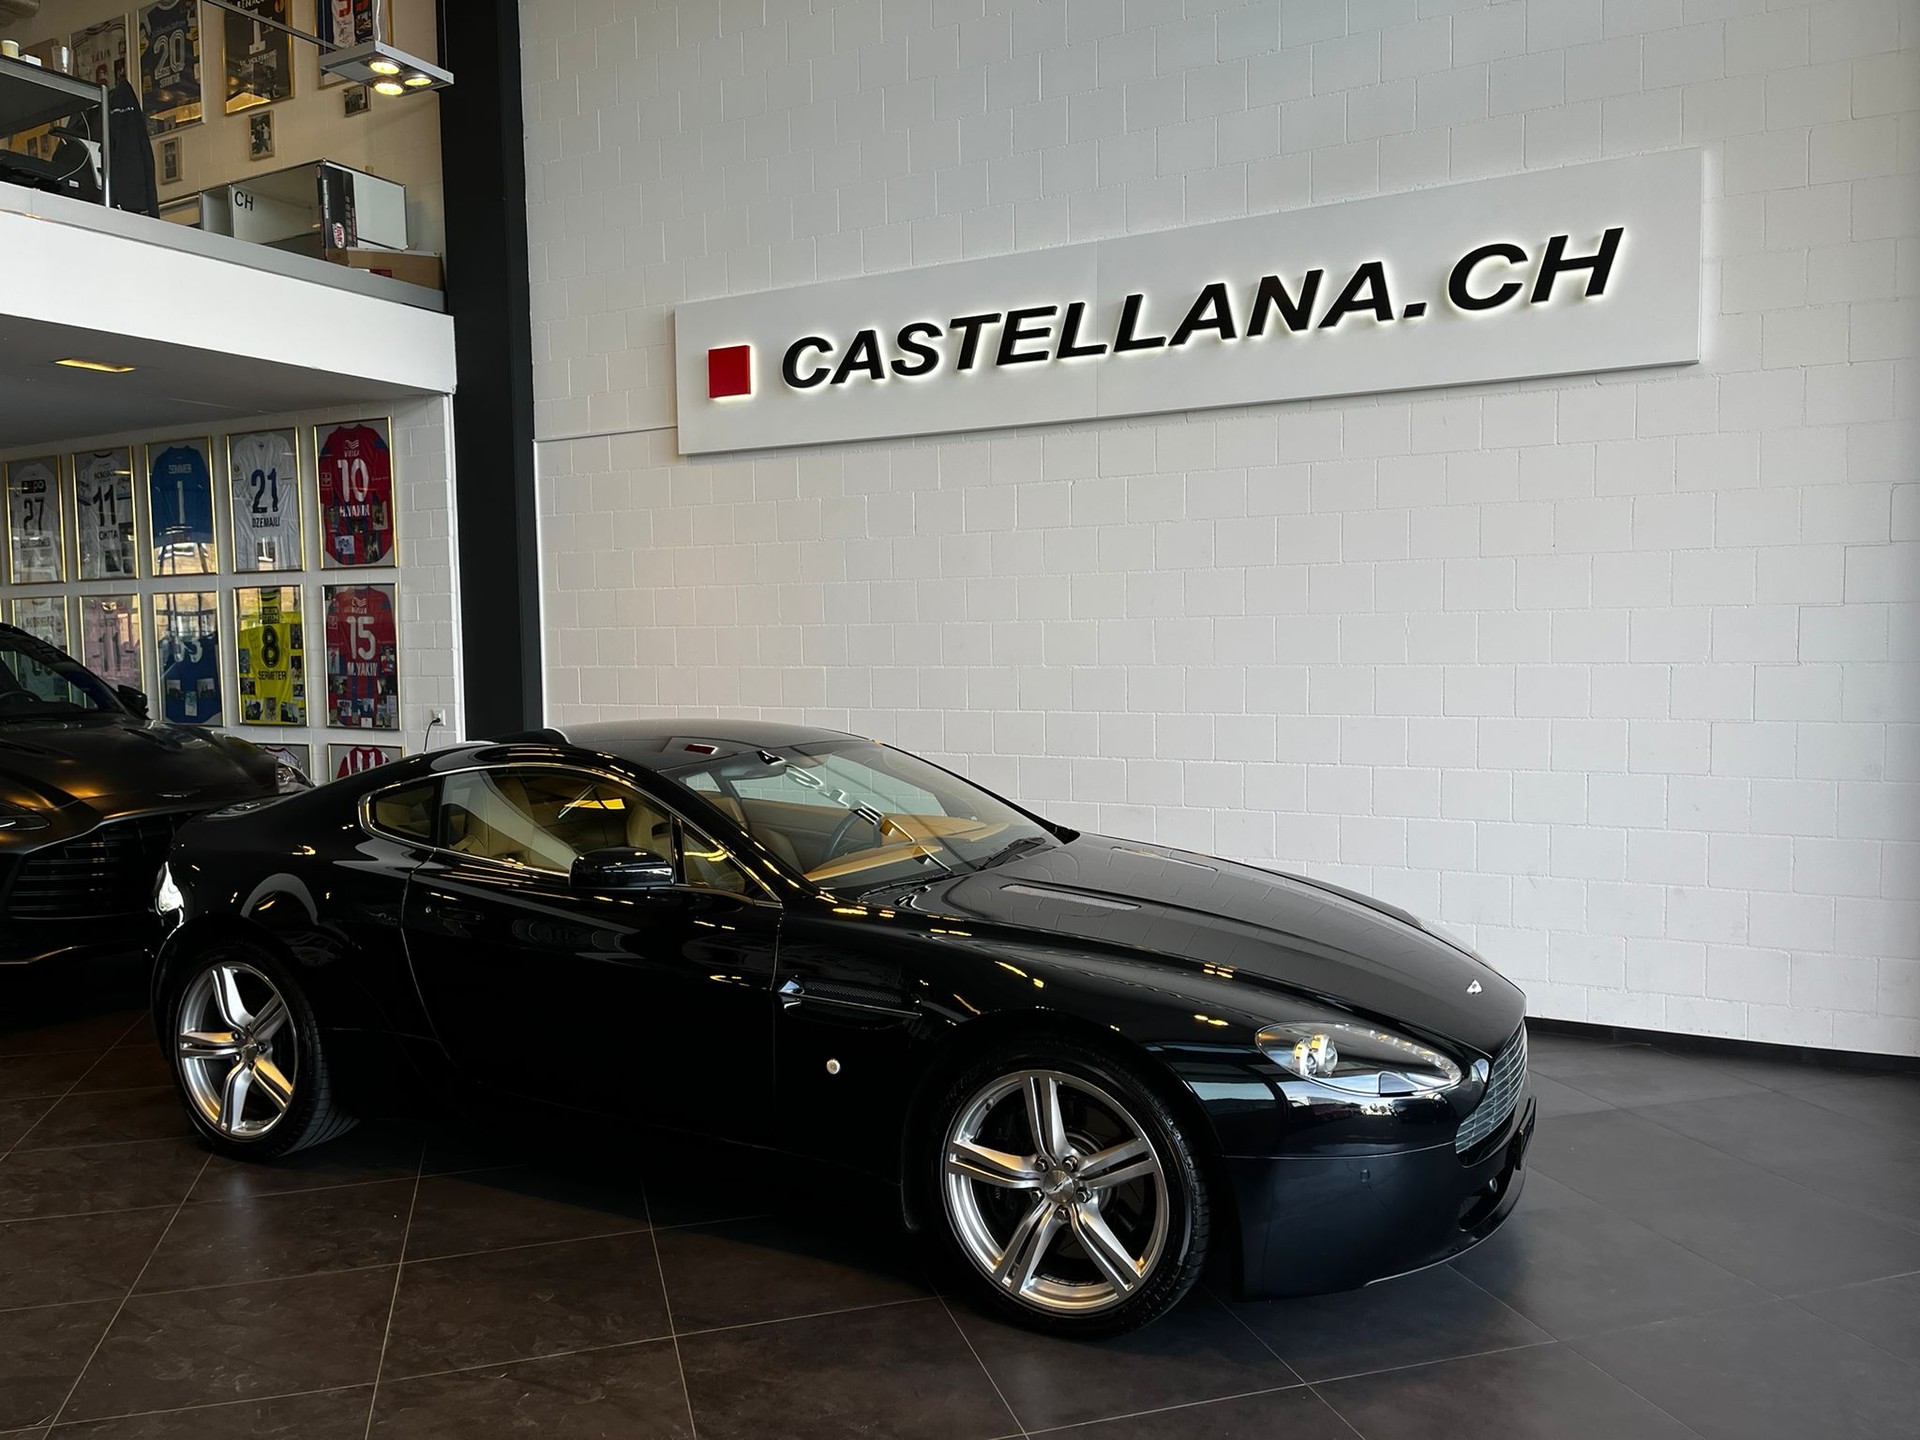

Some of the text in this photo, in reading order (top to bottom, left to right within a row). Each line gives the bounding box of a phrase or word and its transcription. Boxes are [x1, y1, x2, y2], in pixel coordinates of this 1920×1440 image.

[153, 29, 186, 80] 20
[234, 191, 254, 211] CH
[781, 227, 1625, 388] CASTELLANA.CH
[176, 480, 186, 524] 1
[250, 468, 279, 514] 21
[337, 458, 369, 502] 10
[23, 496, 45, 536] 27
[93, 484, 116, 526] 11
[262, 625, 280, 668] 8
[346, 616, 376, 660] 15
